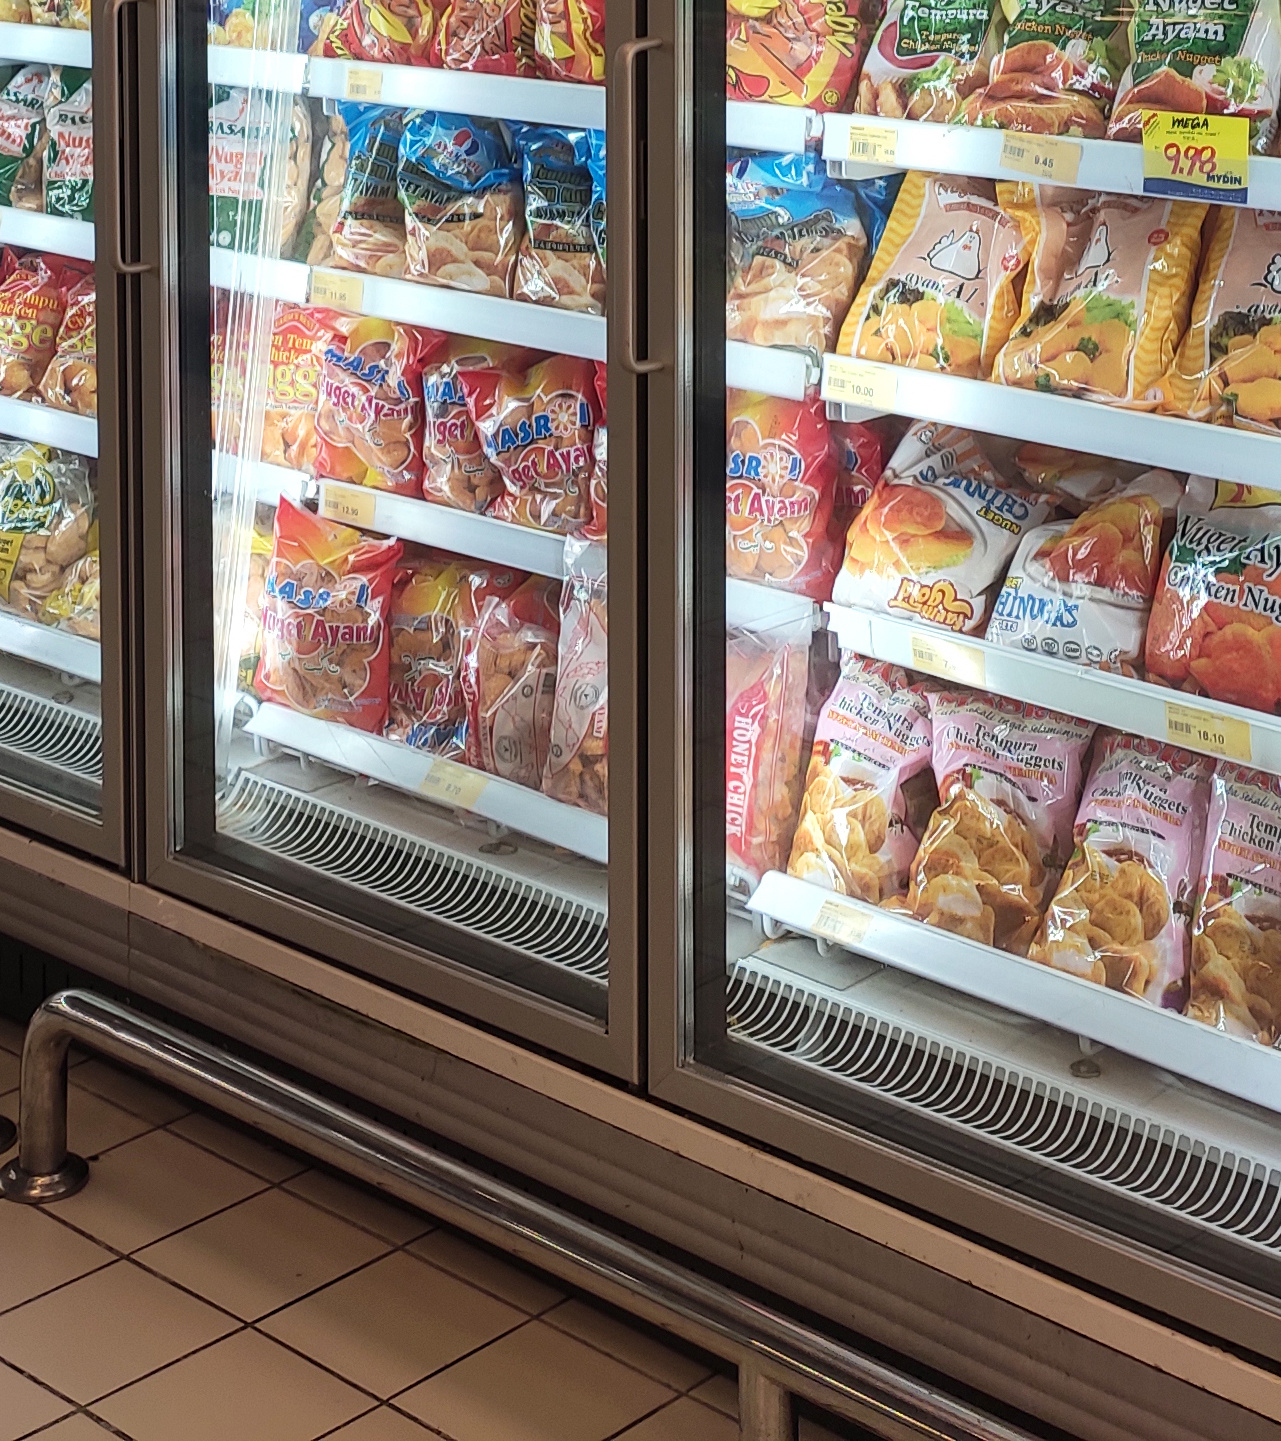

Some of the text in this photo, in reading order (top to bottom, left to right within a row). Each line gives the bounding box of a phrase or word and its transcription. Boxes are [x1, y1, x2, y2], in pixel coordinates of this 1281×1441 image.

[903, 0, 991, 25] Tempura
[1146, 17, 1227, 42] Ayam
[1170, 115, 1209, 132] MEGA
[1163, 142, 1217, 176] 9.98
[1206, 171, 1242, 186] MYDIN
[746, 490, 811, 526] Ayam
[1174, 514, 1245, 559] Nuget
[310, 620, 375, 648] Ayam
[883, 716, 931, 748] Nuggets
[729, 714, 754, 781] HONEY
[1136, 786, 1189, 815] Nuggets
